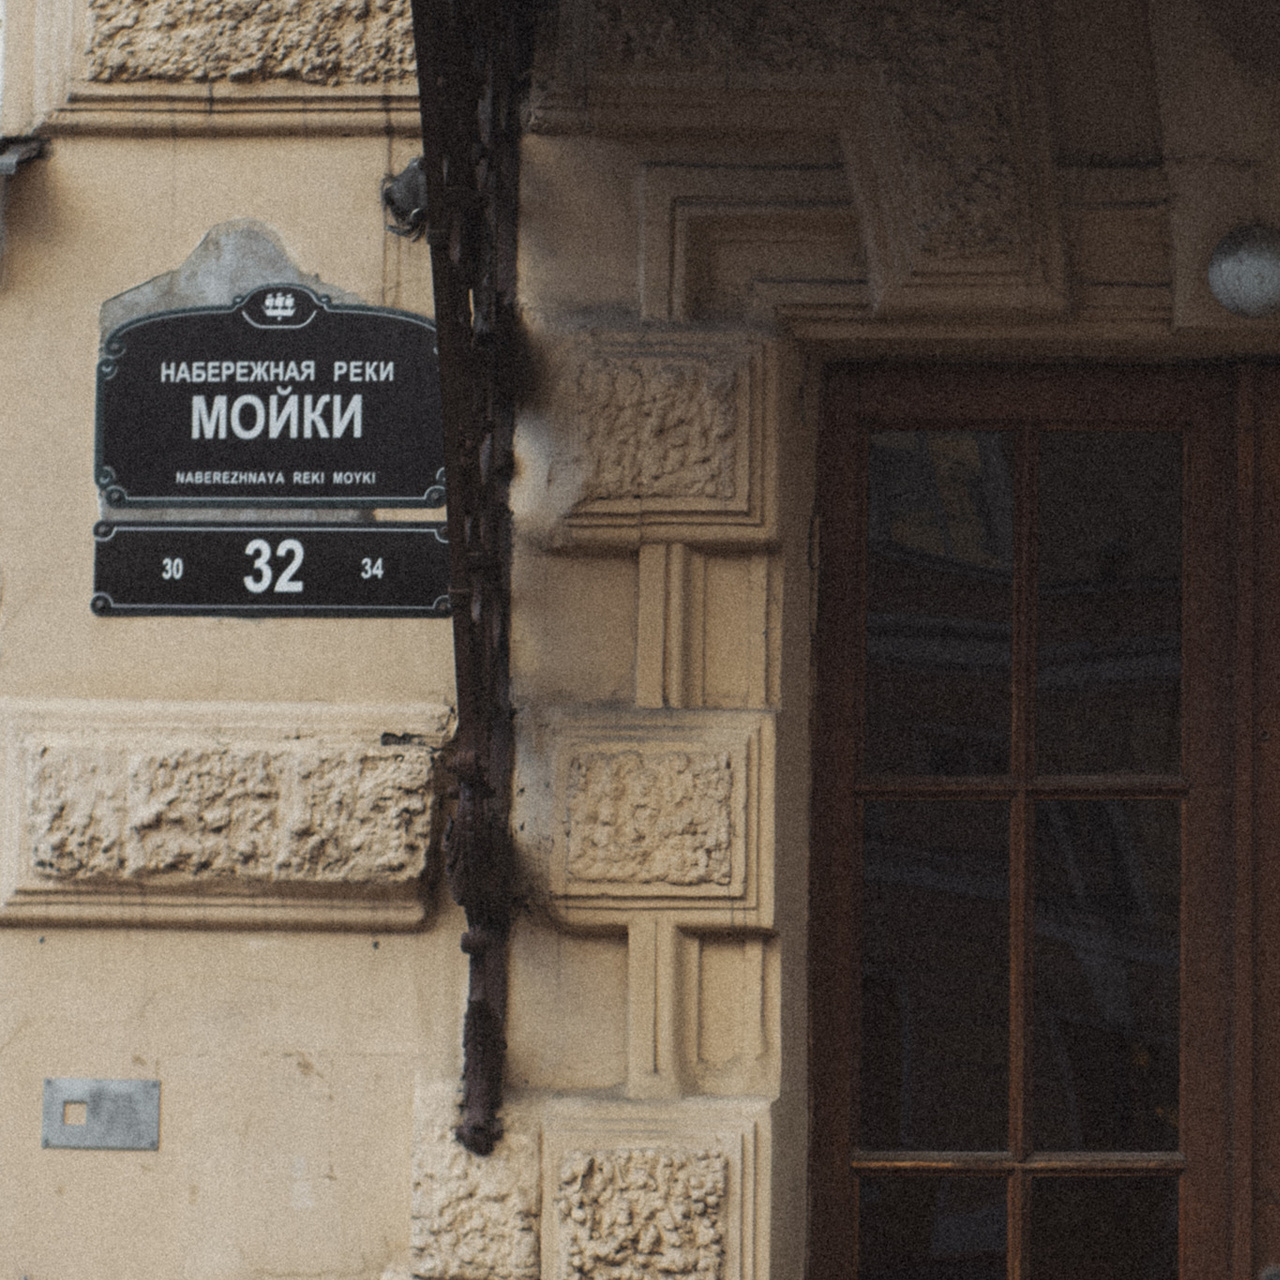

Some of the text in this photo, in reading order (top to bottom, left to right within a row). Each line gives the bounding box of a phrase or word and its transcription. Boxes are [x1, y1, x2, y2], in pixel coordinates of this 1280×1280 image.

[160, 360, 395, 383] НАБЕРЕЖНАЯ РЕКИ
[191, 385, 363, 440] МОЙКИ
[175, 471, 376, 485] NABEREZHNAYA REKI MOYKI
[161, 538, 384, 594] 30 32 34
